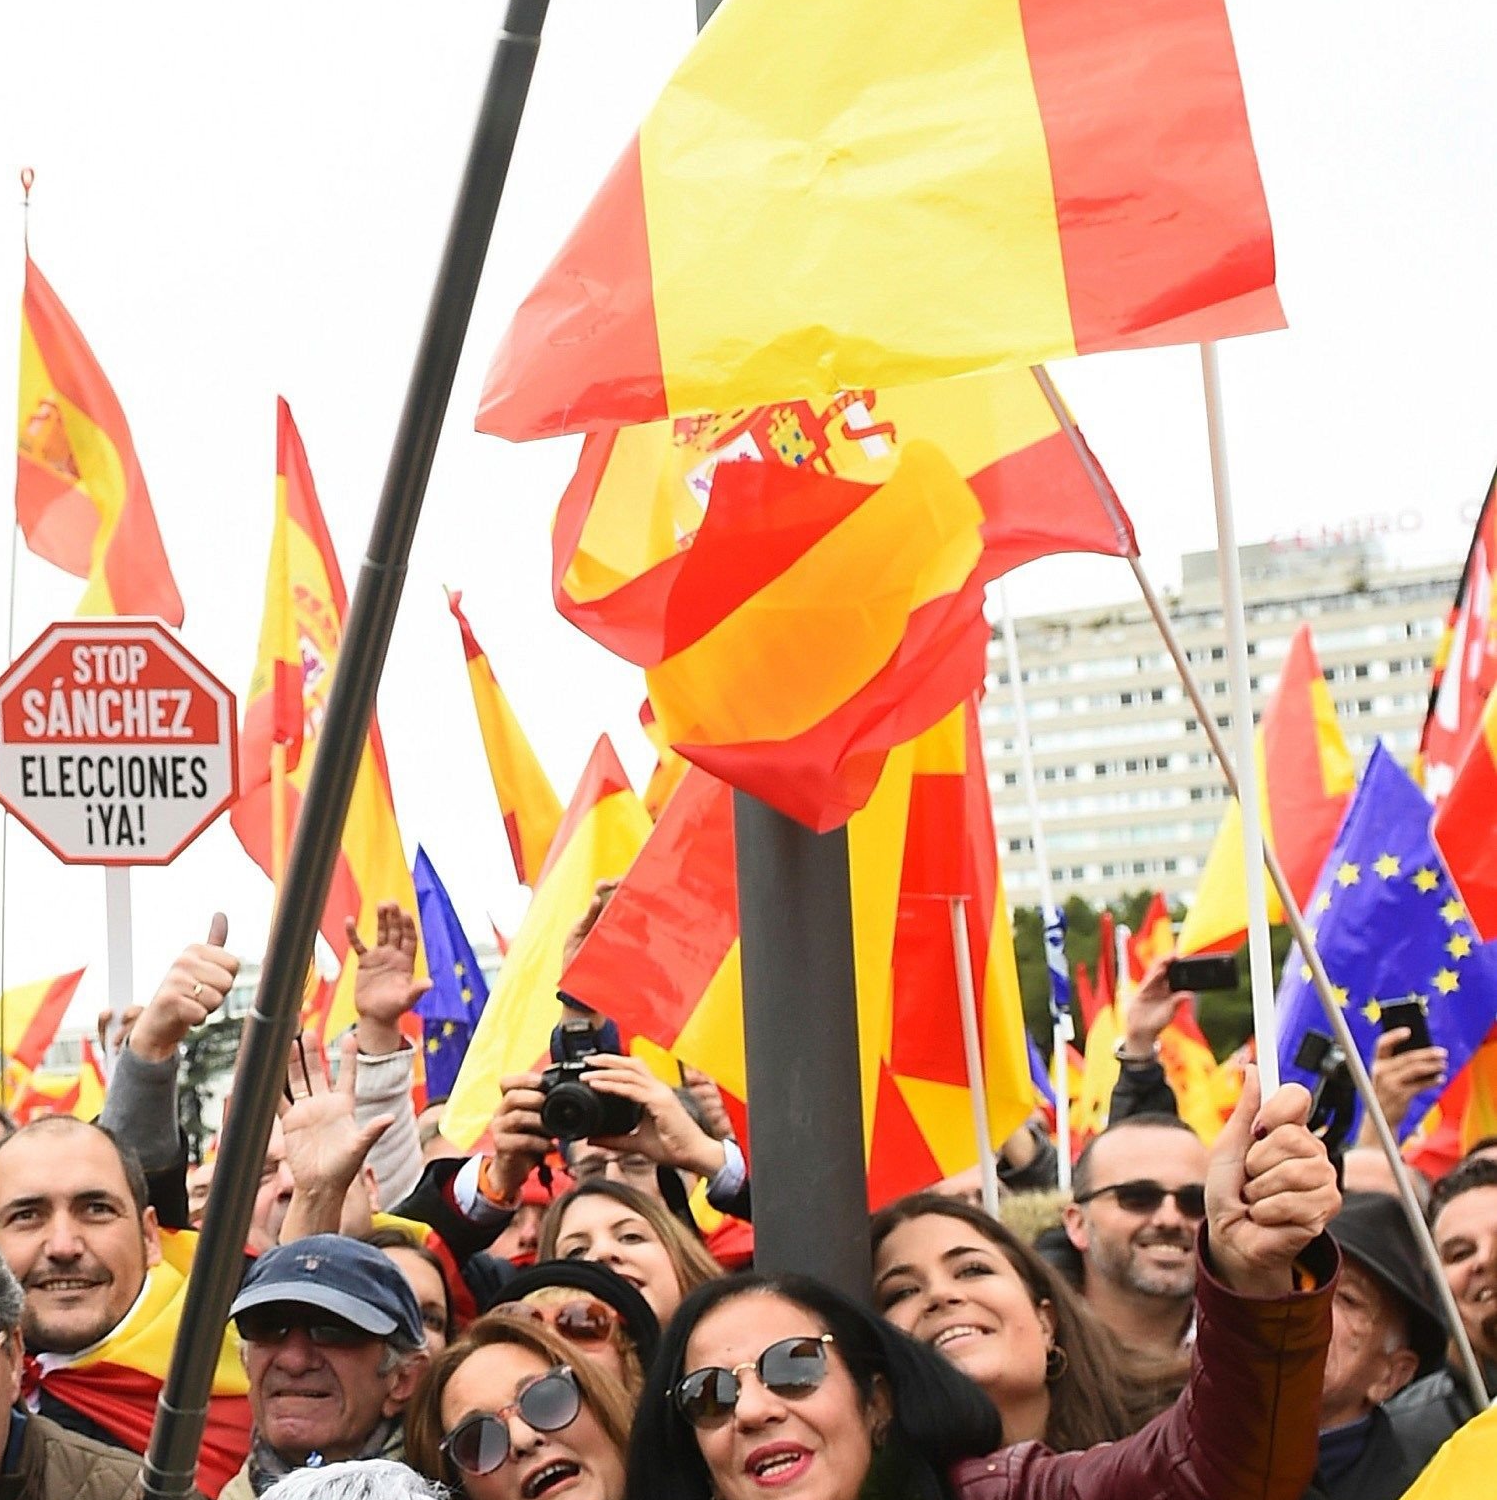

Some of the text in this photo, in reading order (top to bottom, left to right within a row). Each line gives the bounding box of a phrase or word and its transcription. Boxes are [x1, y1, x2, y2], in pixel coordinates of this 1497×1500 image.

[72, 644, 148, 684] STOP
[21, 676, 194, 738] SÁNCHEZ
[21, 755, 208, 799] ELECCIONES
[85, 804, 146, 846] ¡YA!
